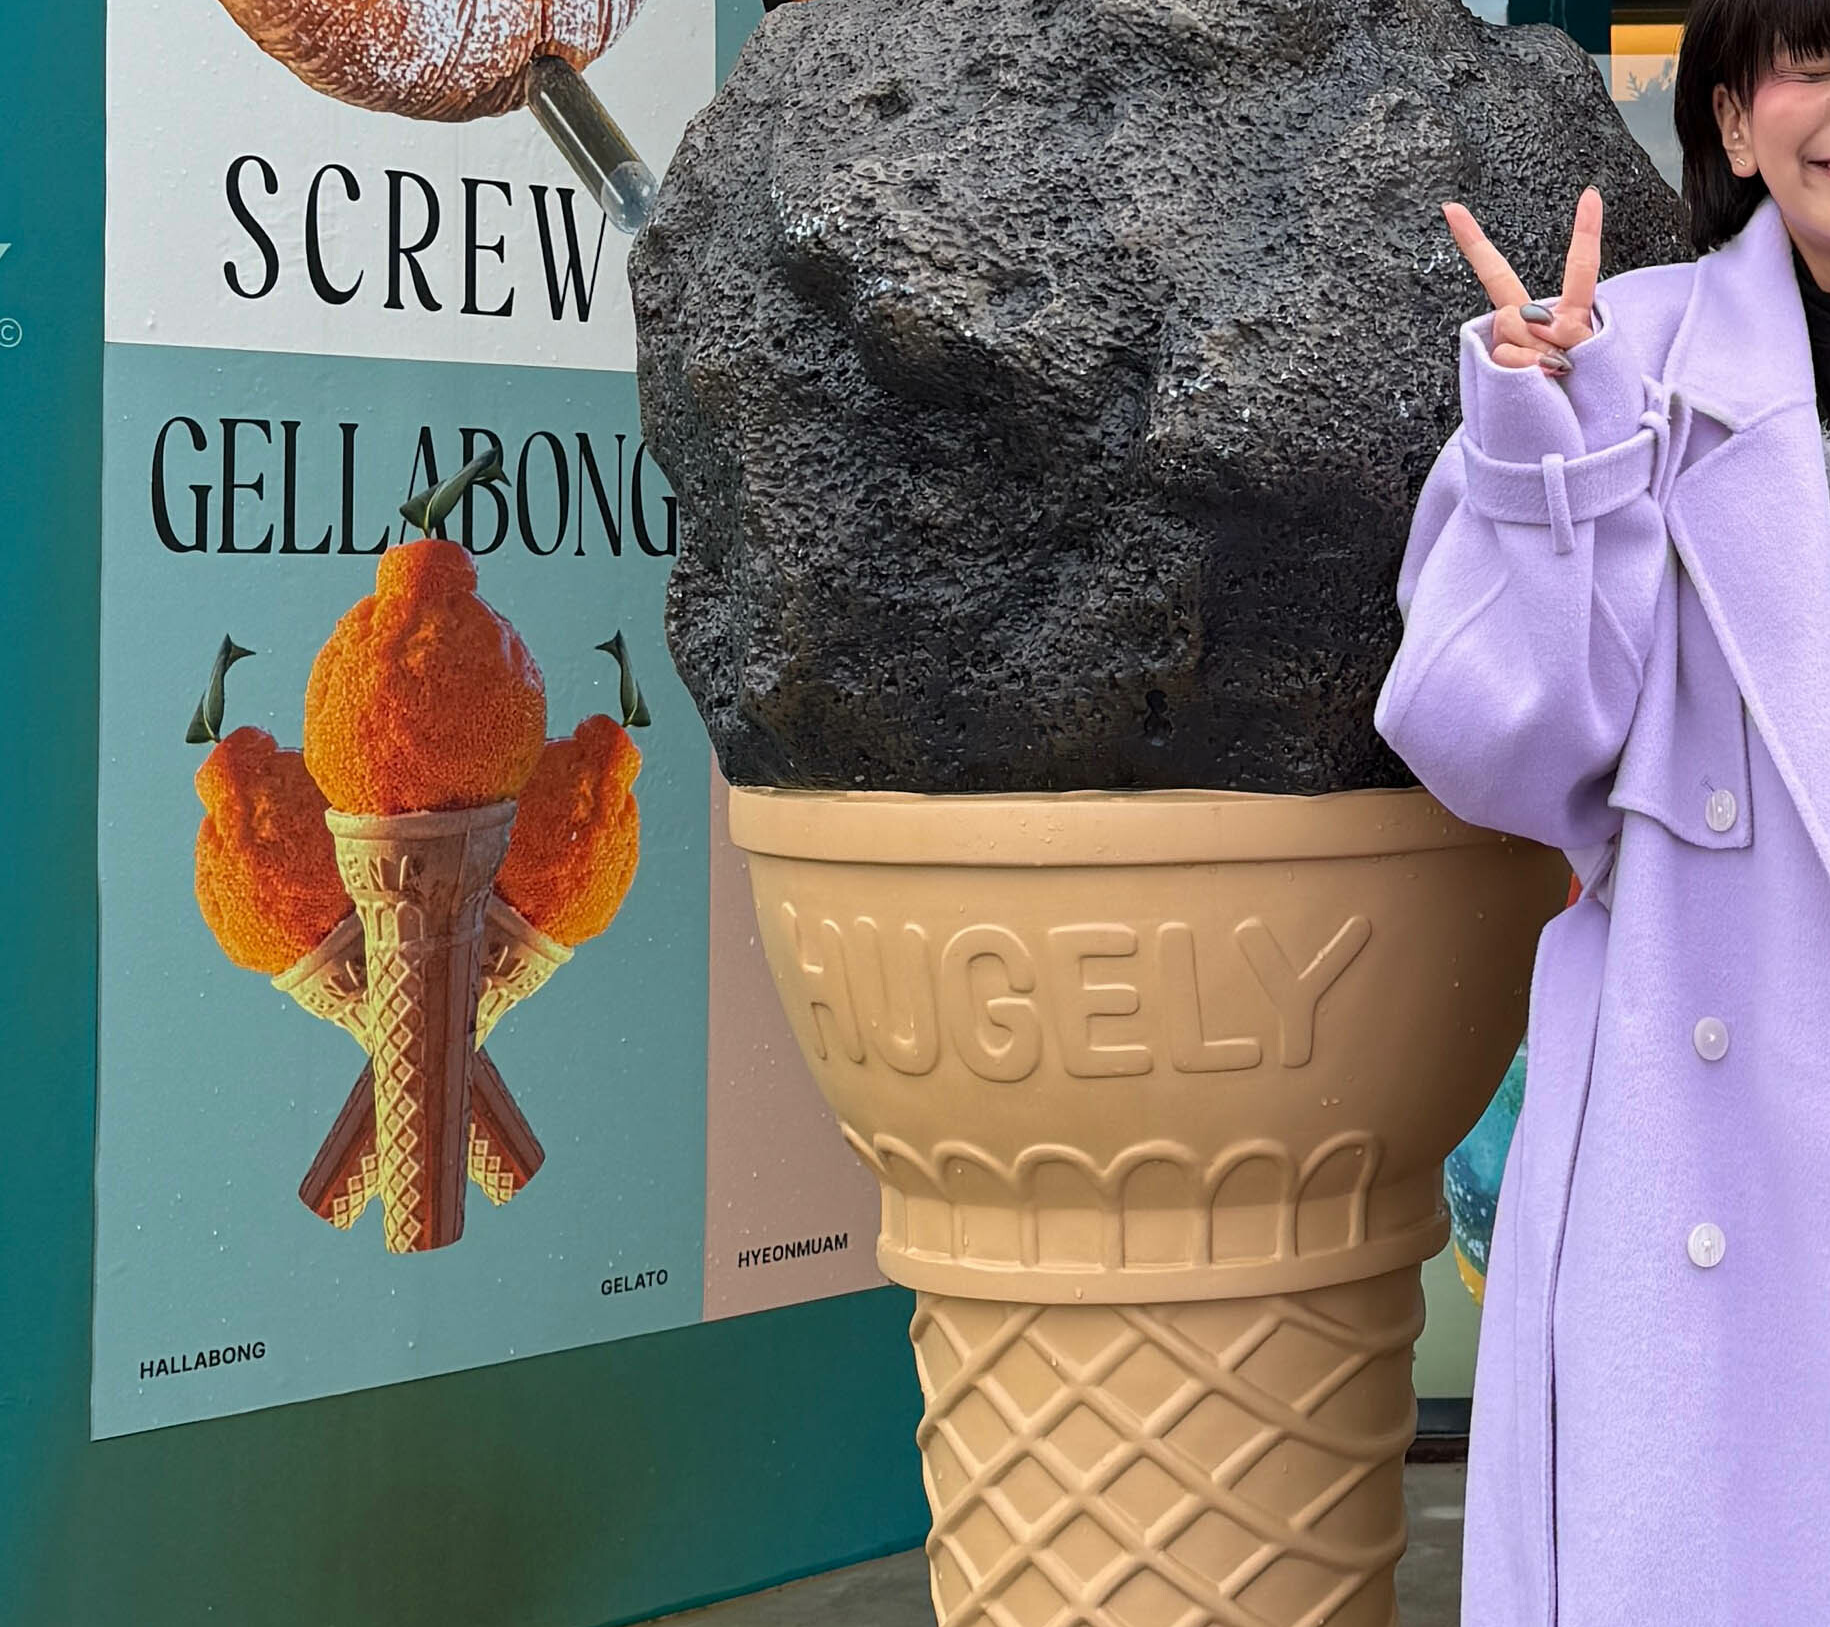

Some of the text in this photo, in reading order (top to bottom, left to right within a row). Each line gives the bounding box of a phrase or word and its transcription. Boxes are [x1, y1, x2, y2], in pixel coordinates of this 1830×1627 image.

[224, 154, 607, 323] SCREW
[151, 416, 679, 558] GELLABONG
[781, 901, 1373, 1083] HUGELY
[600, 1269, 669, 1296] GELATO
[737, 1232, 849, 1269] HYEONMUAM
[139, 1341, 266, 1381] HALLABONG
